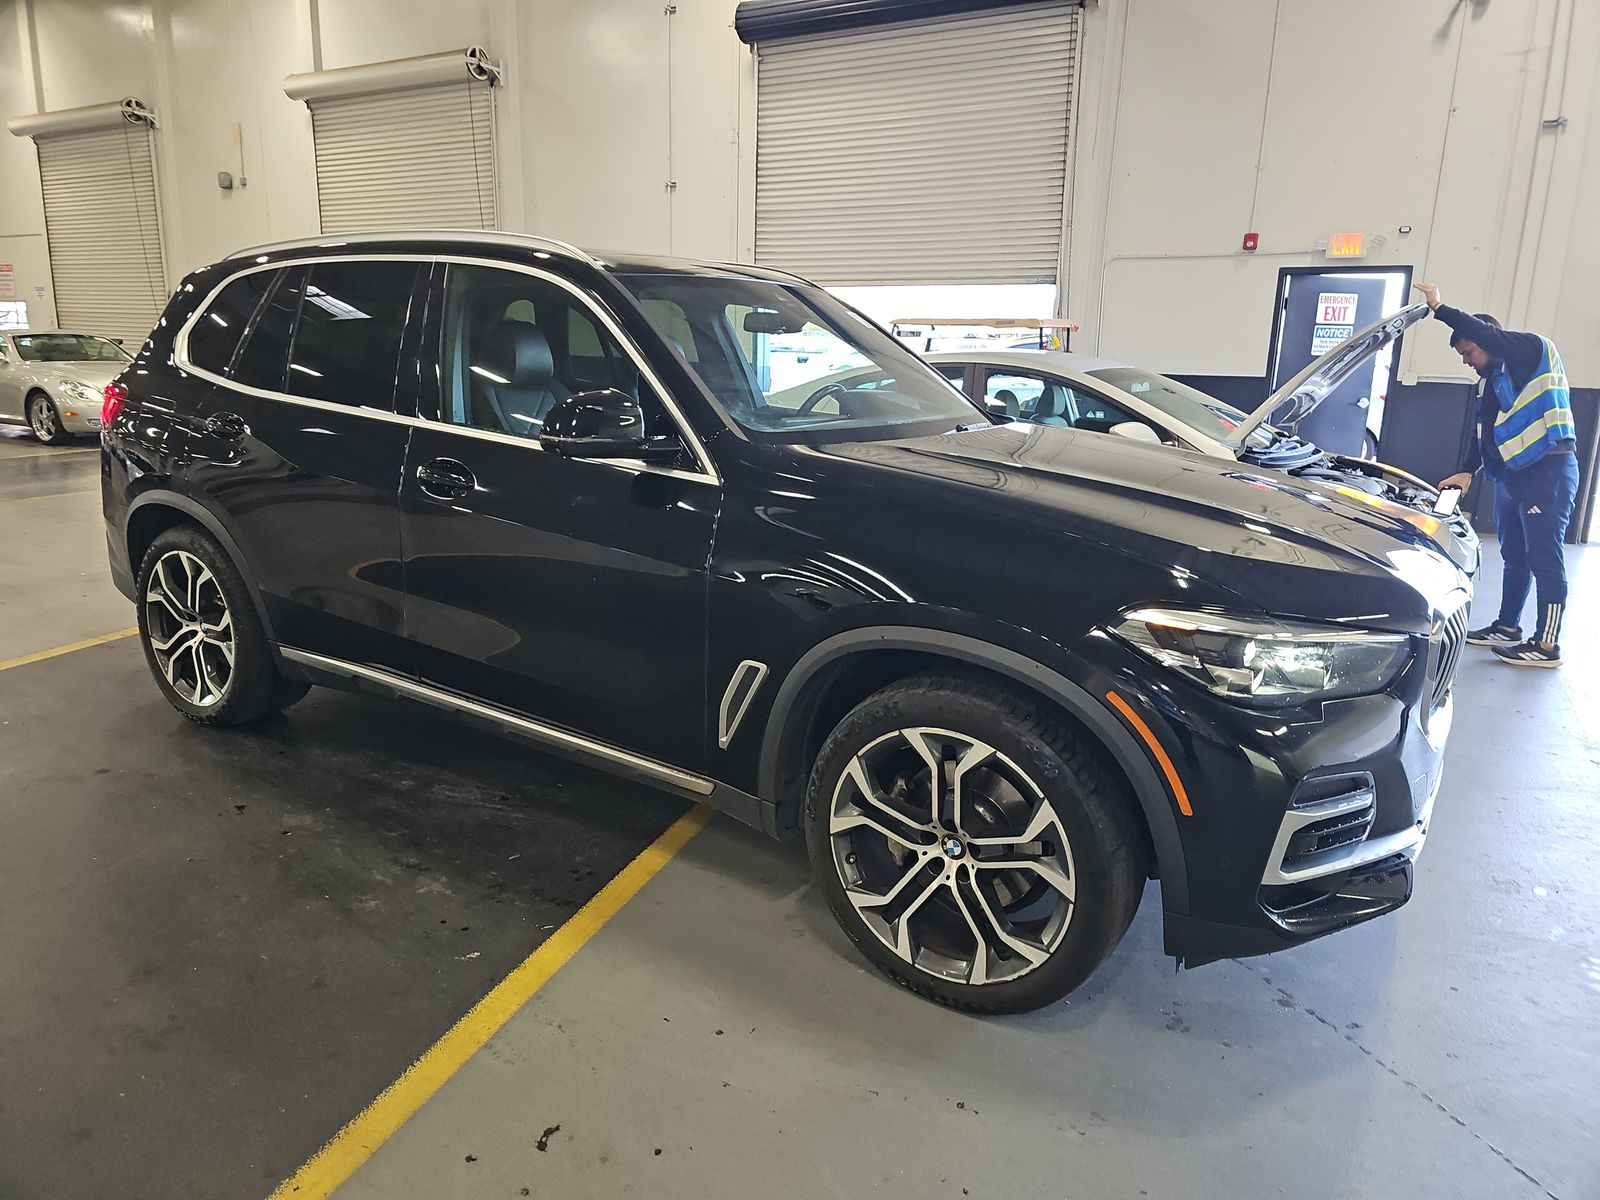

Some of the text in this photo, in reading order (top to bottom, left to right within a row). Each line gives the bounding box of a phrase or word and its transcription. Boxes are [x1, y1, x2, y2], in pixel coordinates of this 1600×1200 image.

[1333, 234, 1363, 255] EXIT
[1320, 295, 1356, 304] EMERGENCY
[1323, 306, 1350, 321] EXIT
[1316, 328, 1351, 338] NOTICE
